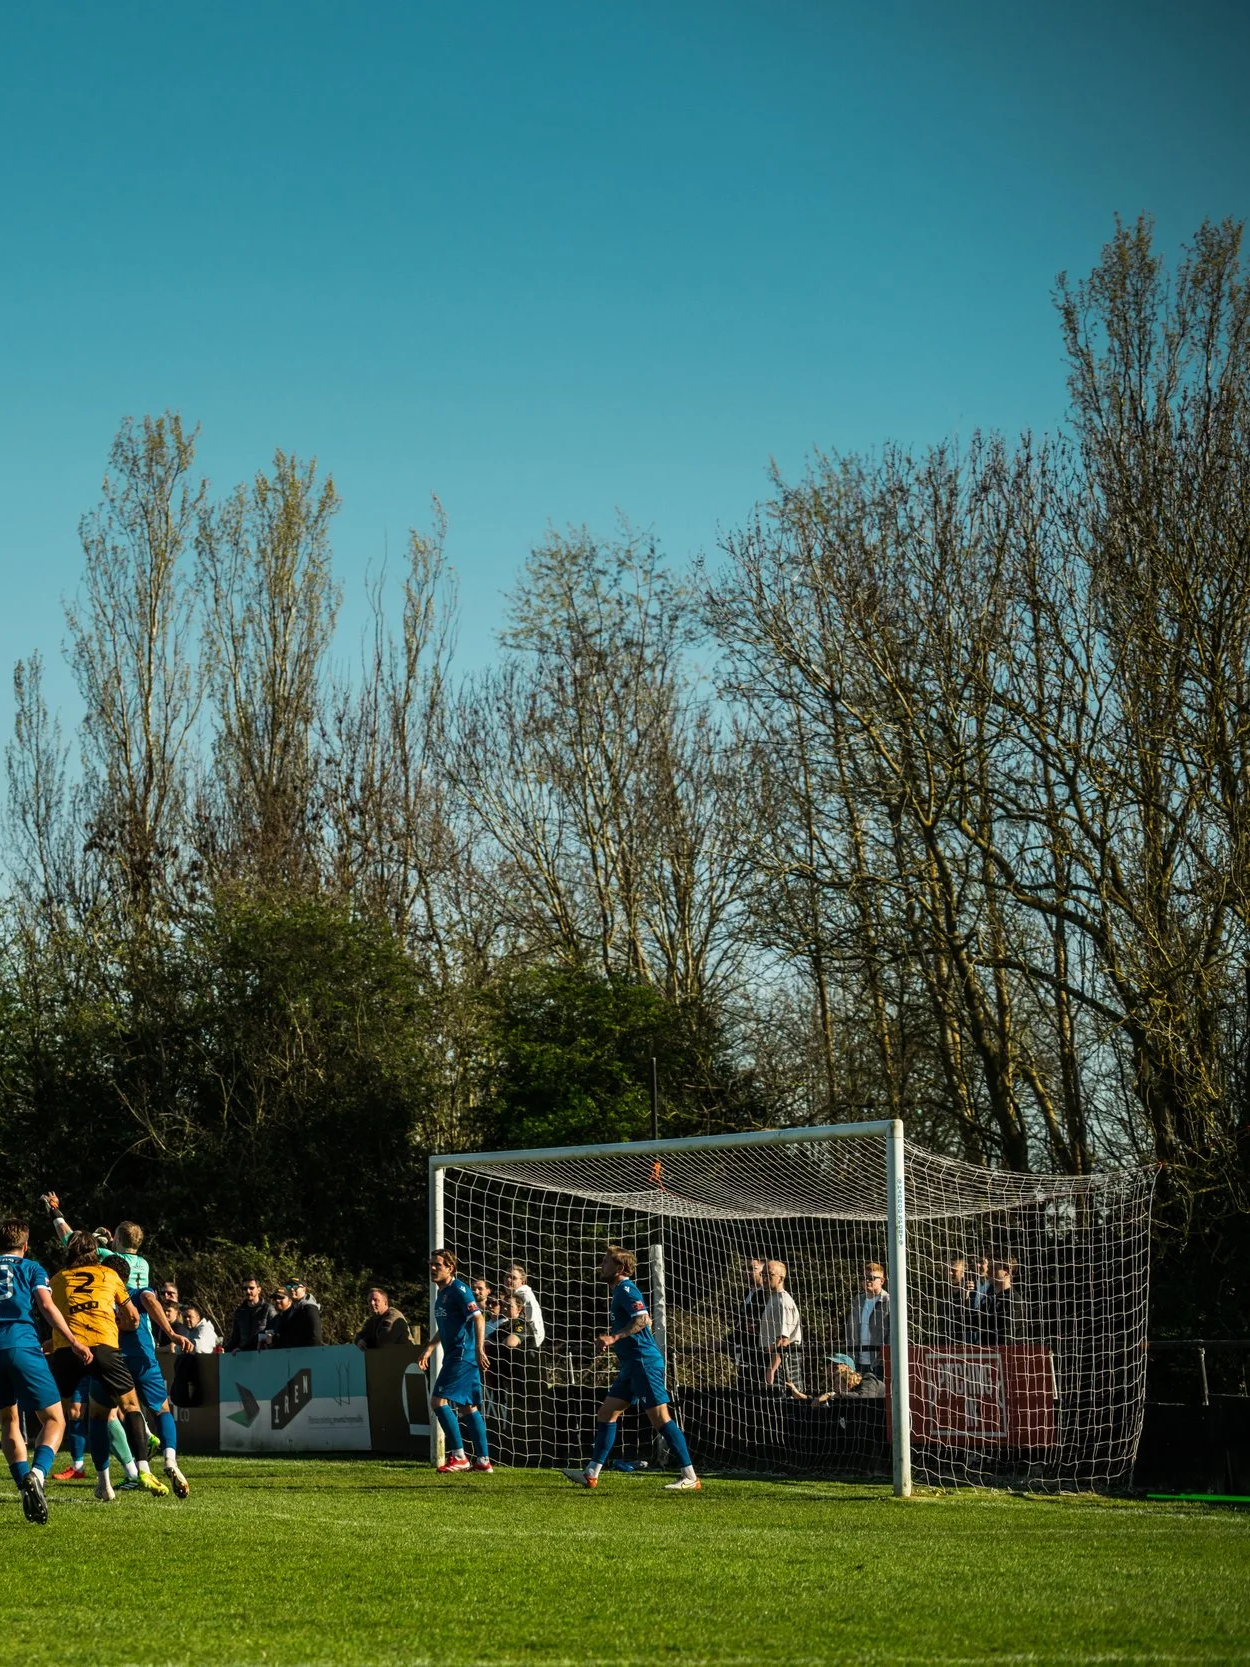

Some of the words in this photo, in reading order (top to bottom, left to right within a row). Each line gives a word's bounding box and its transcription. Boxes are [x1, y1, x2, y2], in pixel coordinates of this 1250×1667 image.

[74, 1272, 95, 1293] 2
[937, 1363, 993, 1395] PITCHING
[274, 1375, 308, 1424] IREN
